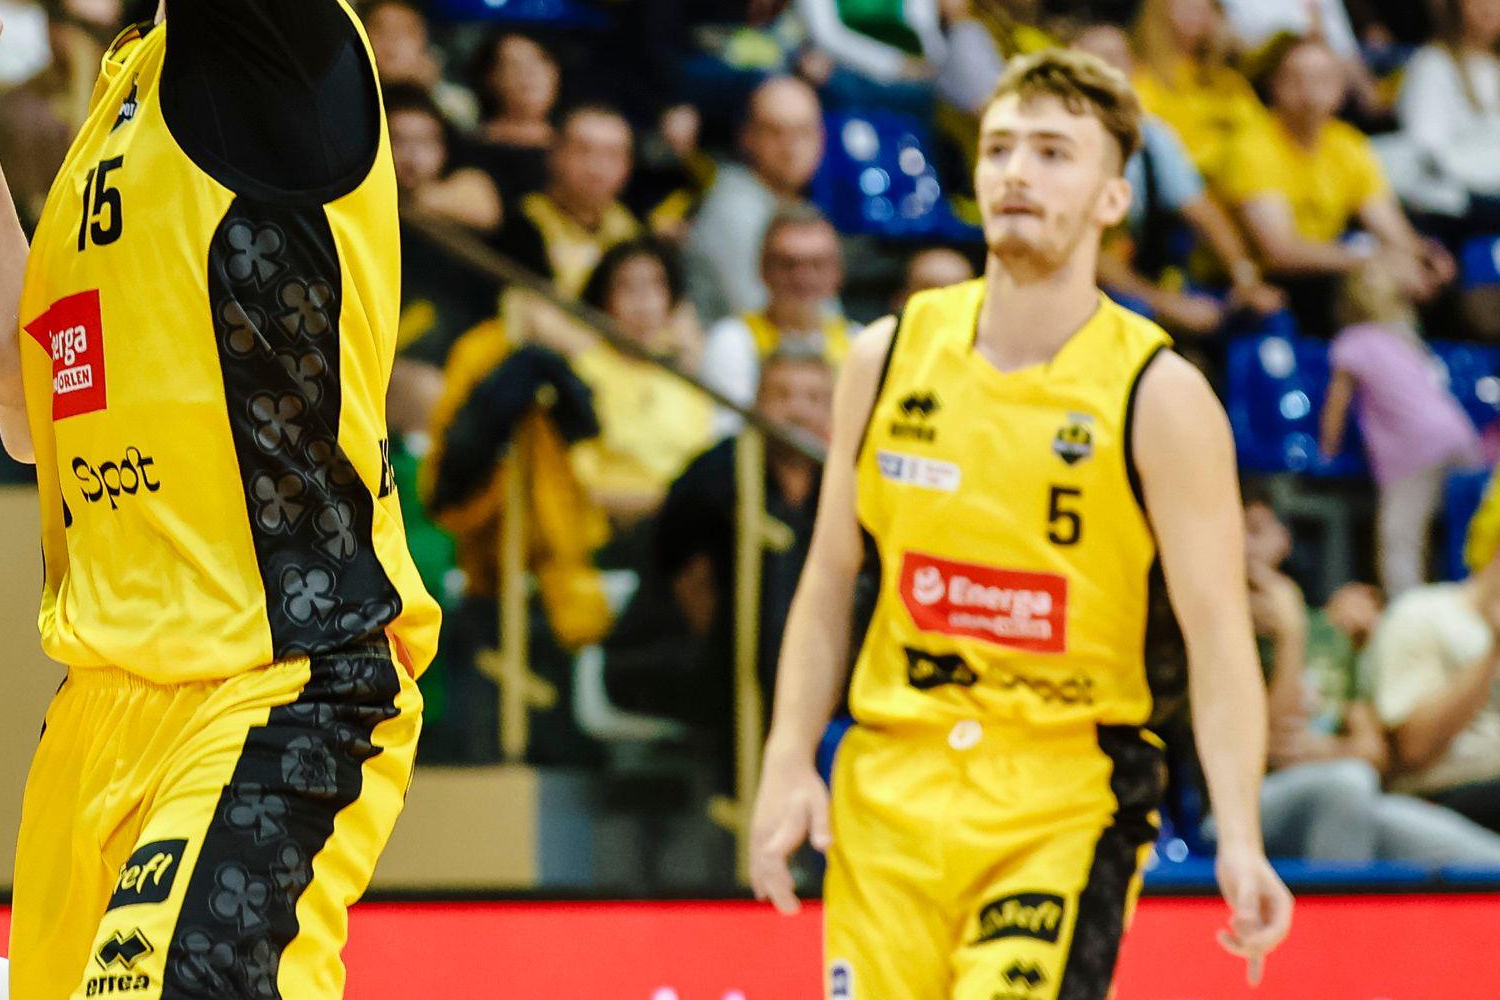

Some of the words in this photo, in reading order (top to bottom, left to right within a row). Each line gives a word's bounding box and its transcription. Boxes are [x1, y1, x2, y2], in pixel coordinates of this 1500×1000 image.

[78, 155, 124, 252] 15
[58, 368, 90, 390] ORLEN
[1047, 485, 1082, 546] 5
